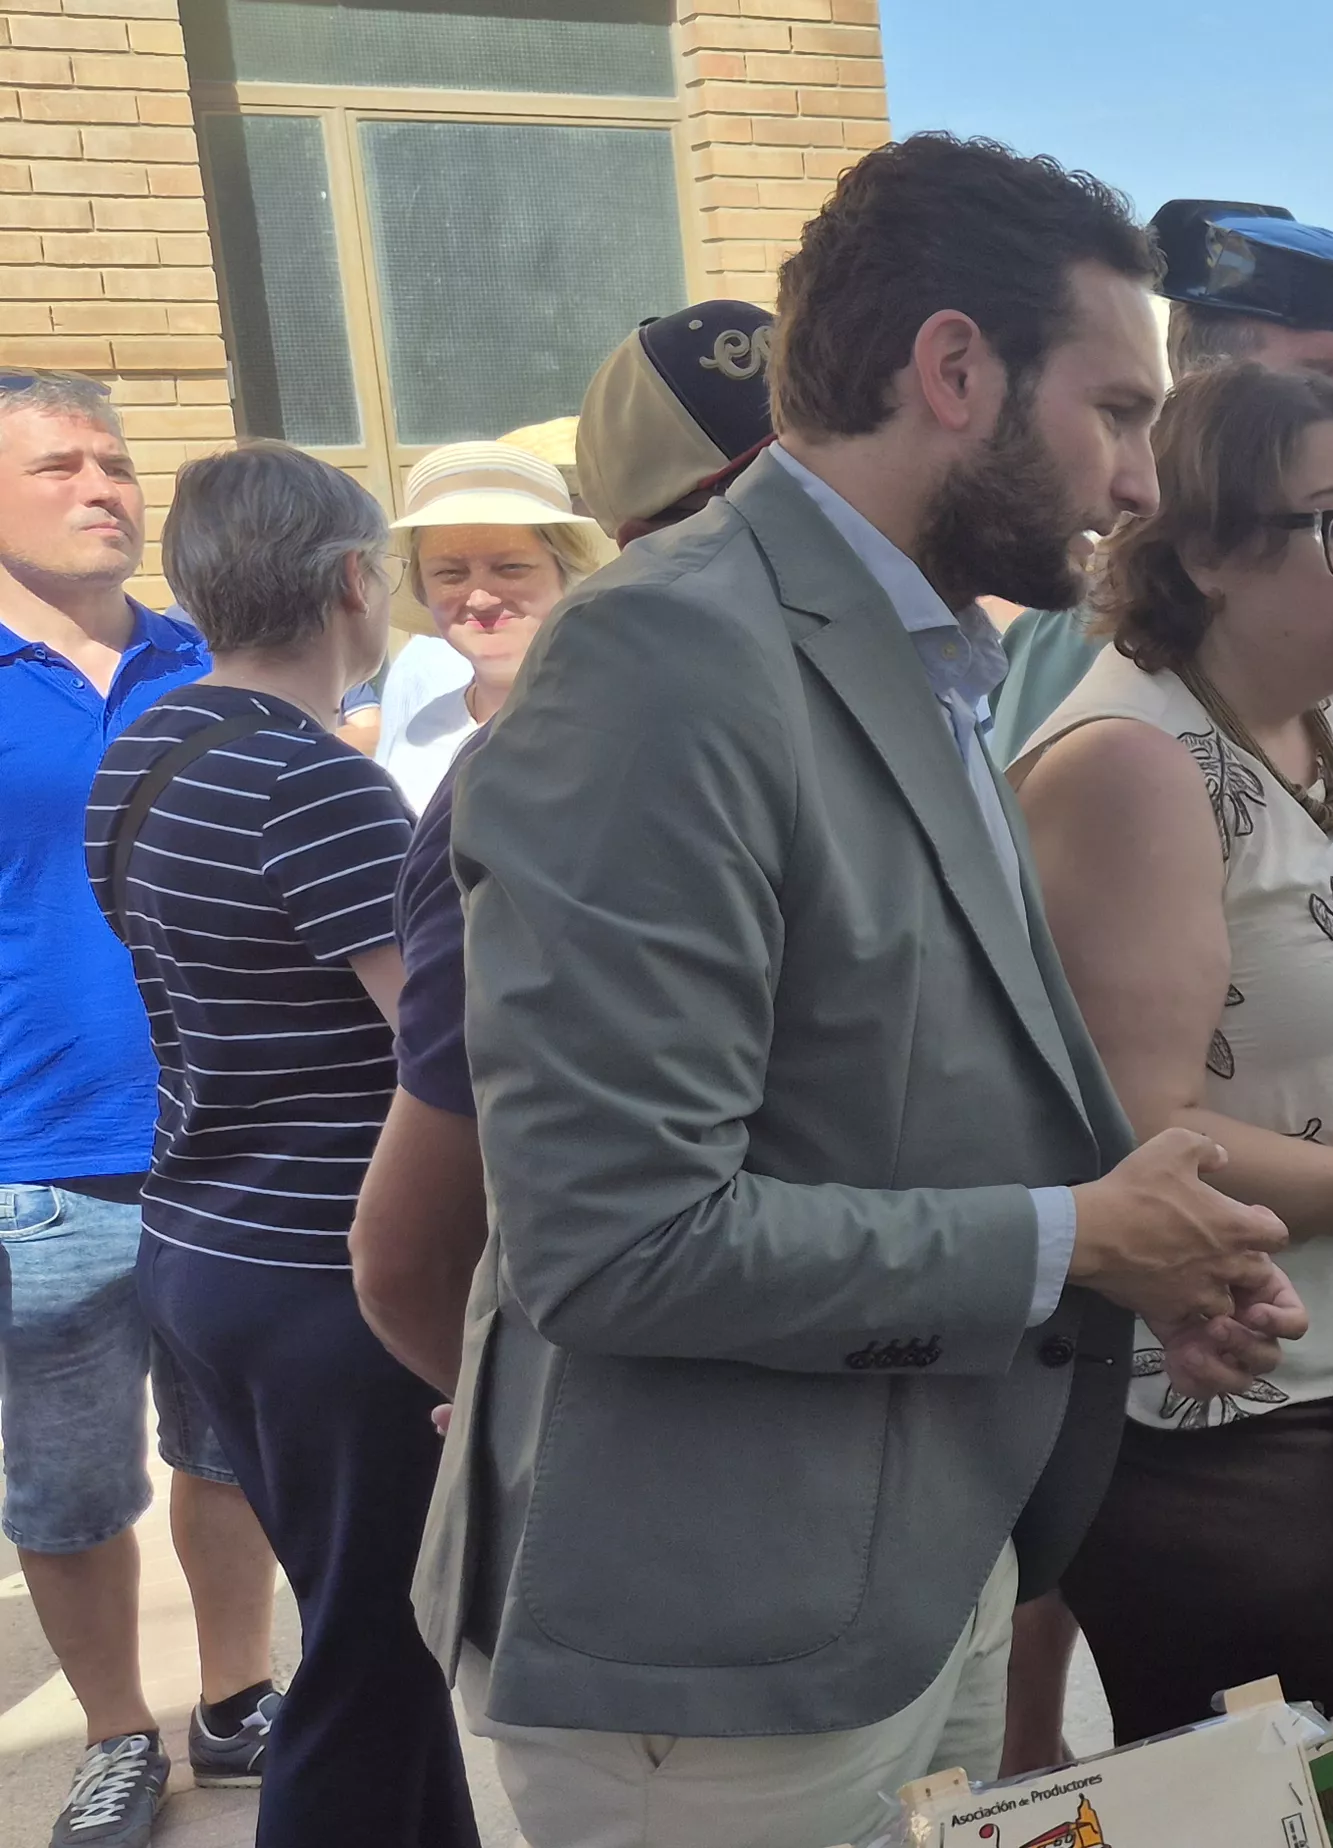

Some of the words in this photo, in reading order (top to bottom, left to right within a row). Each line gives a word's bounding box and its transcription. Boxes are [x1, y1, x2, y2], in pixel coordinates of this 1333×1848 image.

[951, 1799, 1017, 1828] Asociación
[1018, 1798, 1030, 1807] de
[1030, 1773, 1103, 1804] Productores
